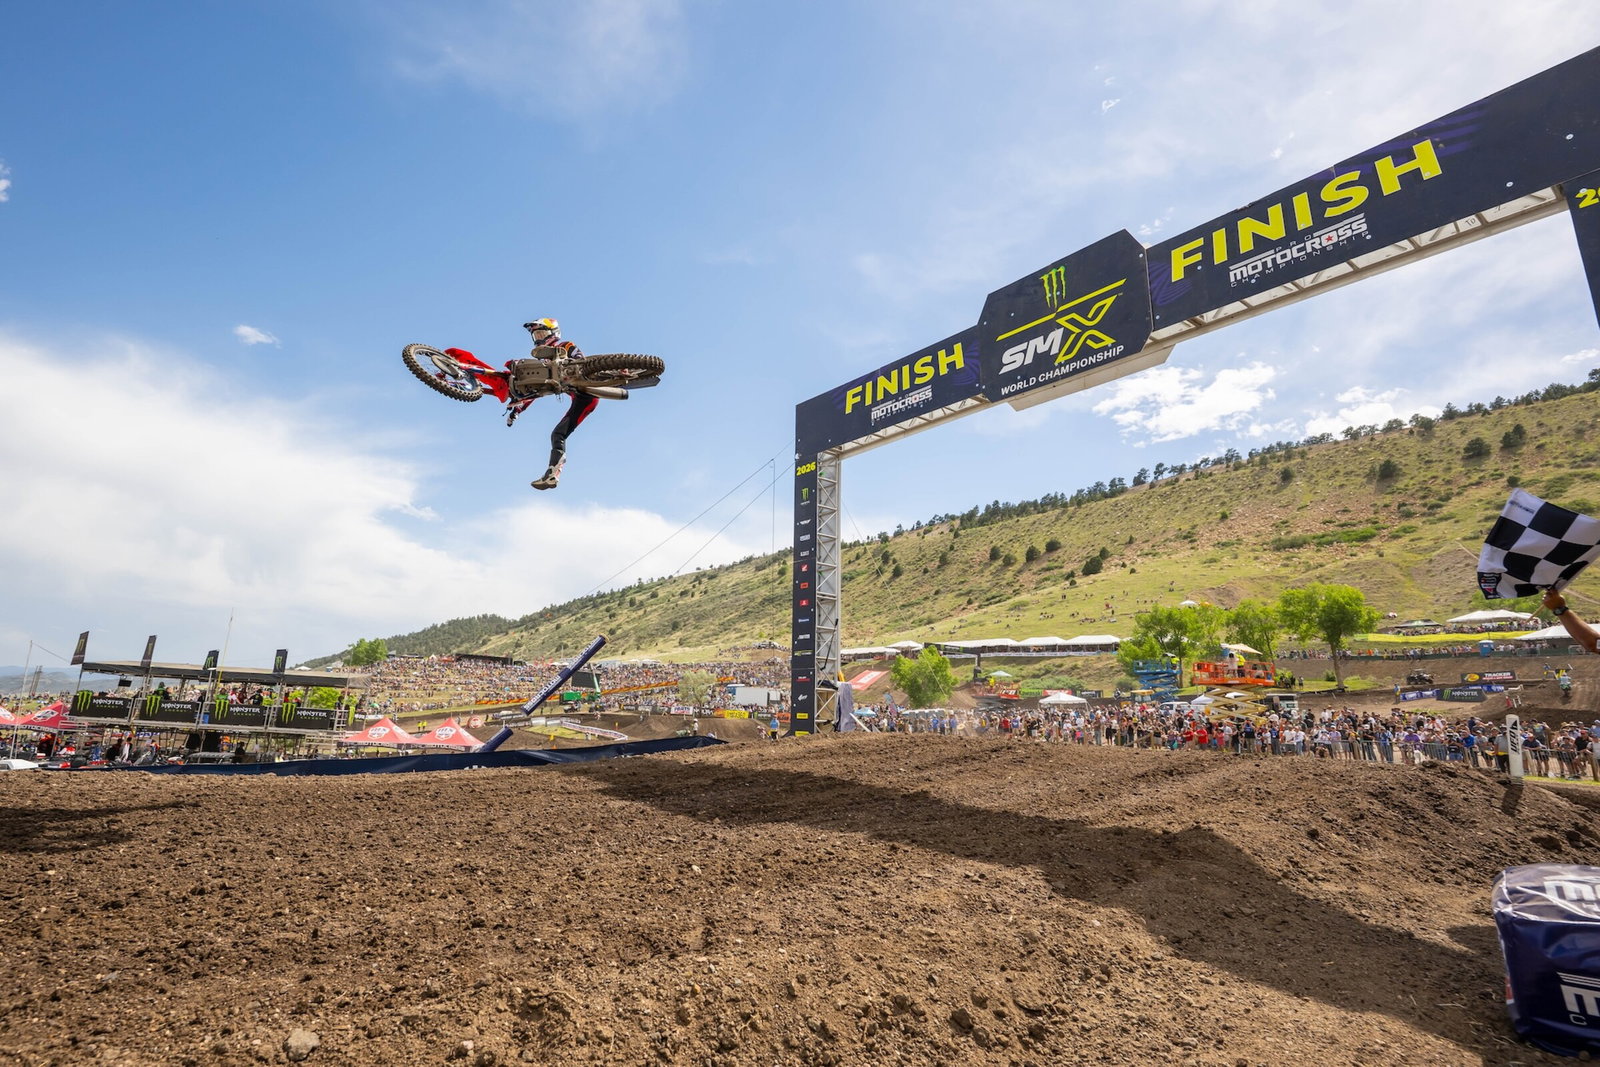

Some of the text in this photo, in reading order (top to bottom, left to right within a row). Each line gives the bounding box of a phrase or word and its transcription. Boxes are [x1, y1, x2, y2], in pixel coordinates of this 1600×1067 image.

[1575, 187, 1600, 208] 2
[1171, 139, 1442, 283] FINISH
[1229, 217, 1368, 283] MOTOCROSS
[1276, 234, 1312, 253] PRO
[1230, 230, 1369, 288] CHAMPIONSHIP
[998, 294, 1118, 375] SMX
[844, 342, 965, 415] FINISH
[1000, 344, 1124, 396] WORLD CHAMPIONSHIP
[871, 388, 933, 420] MOTOCROSS
[796, 461, 816, 477] 2026
[92, 698, 124, 706] MONSTER
[161, 702, 192, 710] MONSTER
[229, 706, 261, 714] MONSTER
[297, 710, 327, 718] MONSTER
